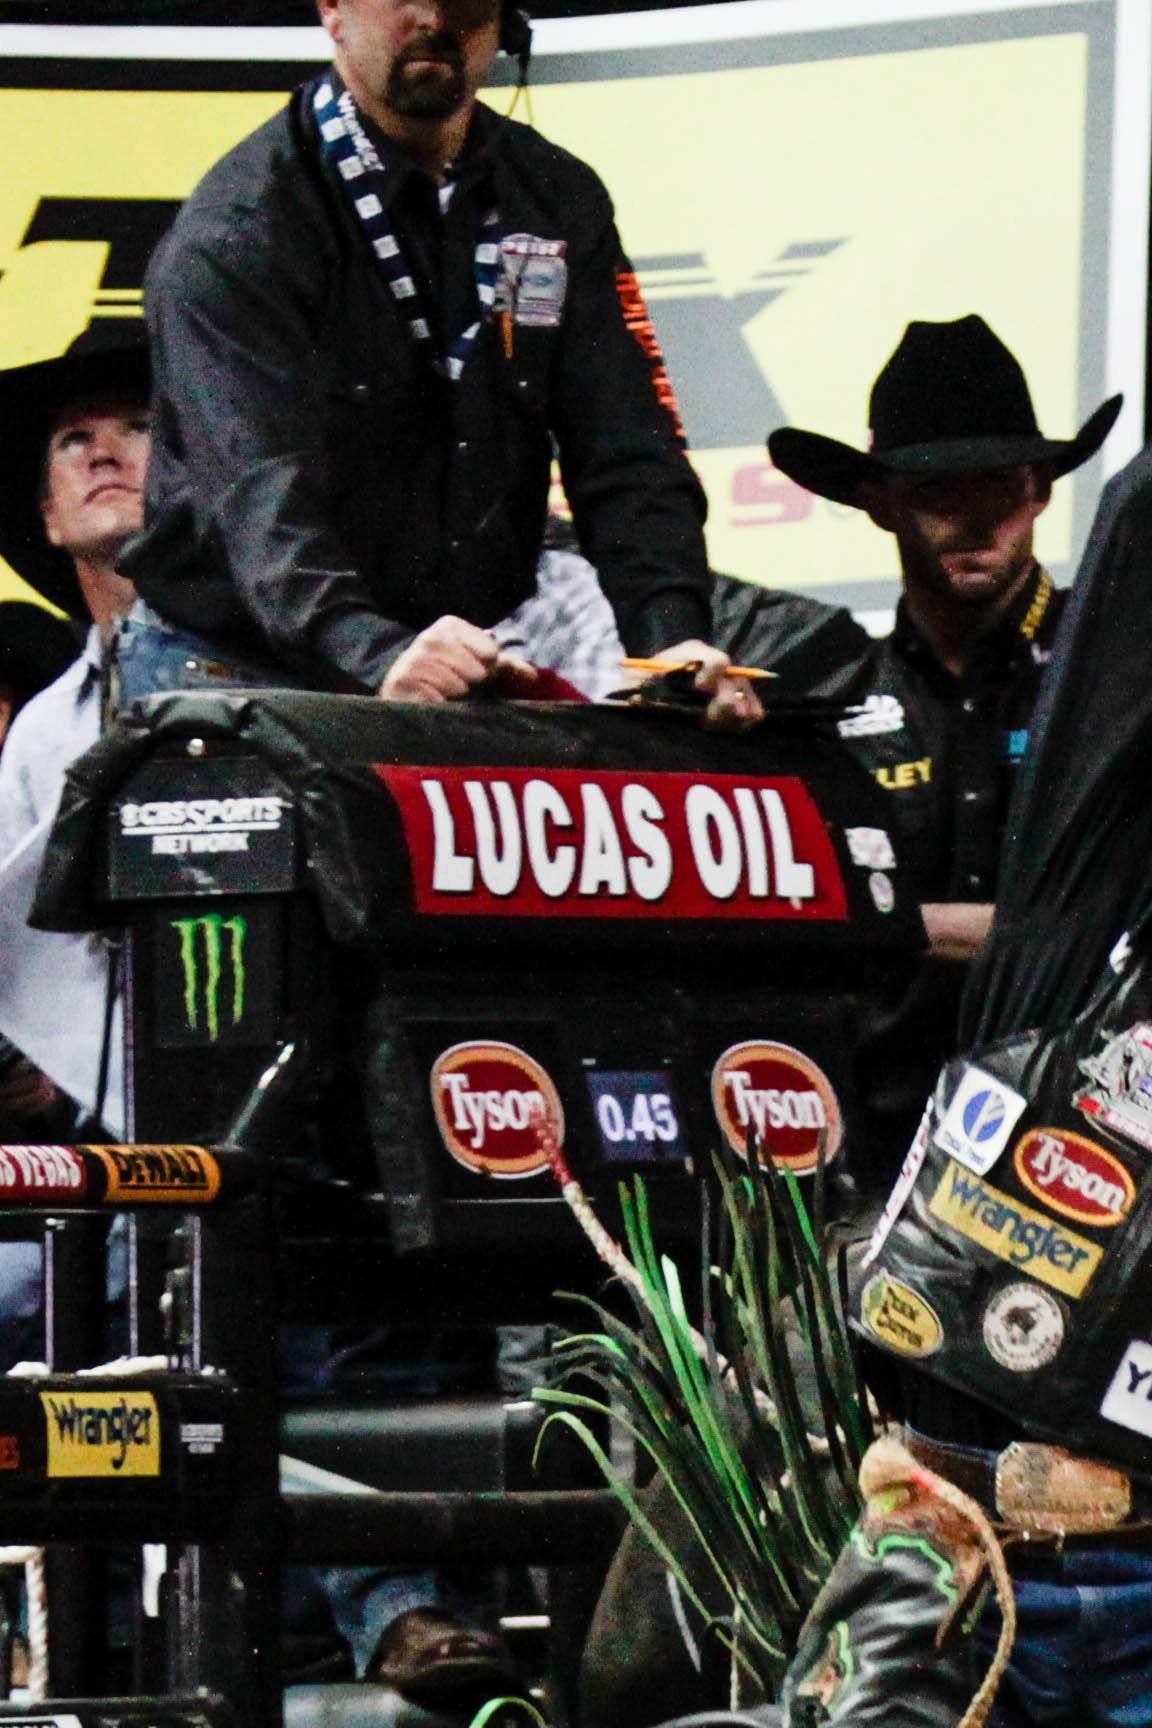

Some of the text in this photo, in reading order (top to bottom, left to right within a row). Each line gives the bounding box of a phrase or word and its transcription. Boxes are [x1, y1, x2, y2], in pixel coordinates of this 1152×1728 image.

[152, 833, 249, 854] NETWORK
[421, 779, 672, 900] LUCAS
[685, 784, 814, 899] OIL
[441, 1073, 547, 1149] Tyson
[600, 1094, 679, 1142] 0.45
[723, 1071, 827, 1146] Tyson
[1030, 1132, 1125, 1213] Tyson
[950, 1167, 1089, 1273] Wrangler
[47, 1397, 152, 1470] Wrangler
